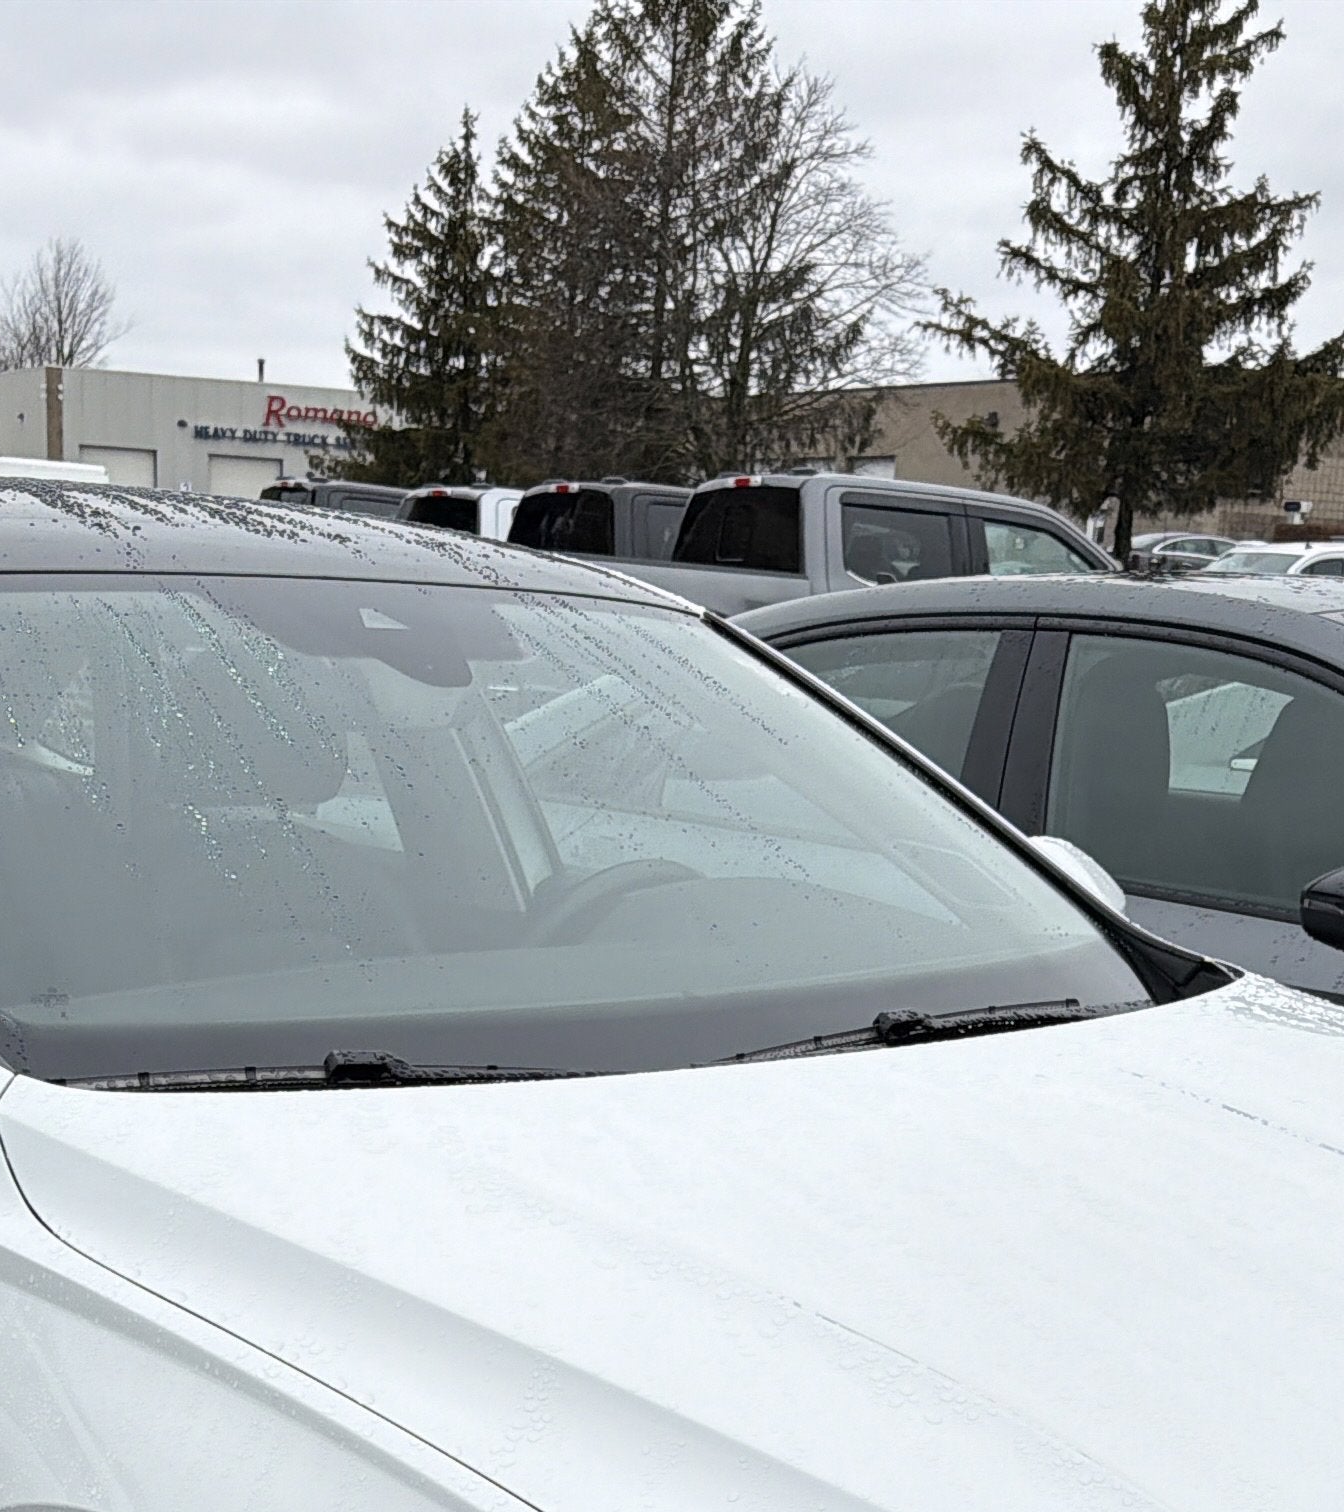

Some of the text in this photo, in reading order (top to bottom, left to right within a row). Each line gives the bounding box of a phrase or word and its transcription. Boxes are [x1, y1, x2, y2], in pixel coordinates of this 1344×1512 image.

[262, 395, 378, 428] Romano
[193, 425, 238, 441] HEAVY
[243, 428, 279, 443] DUTY
[285, 431, 329, 447] TRUCK
